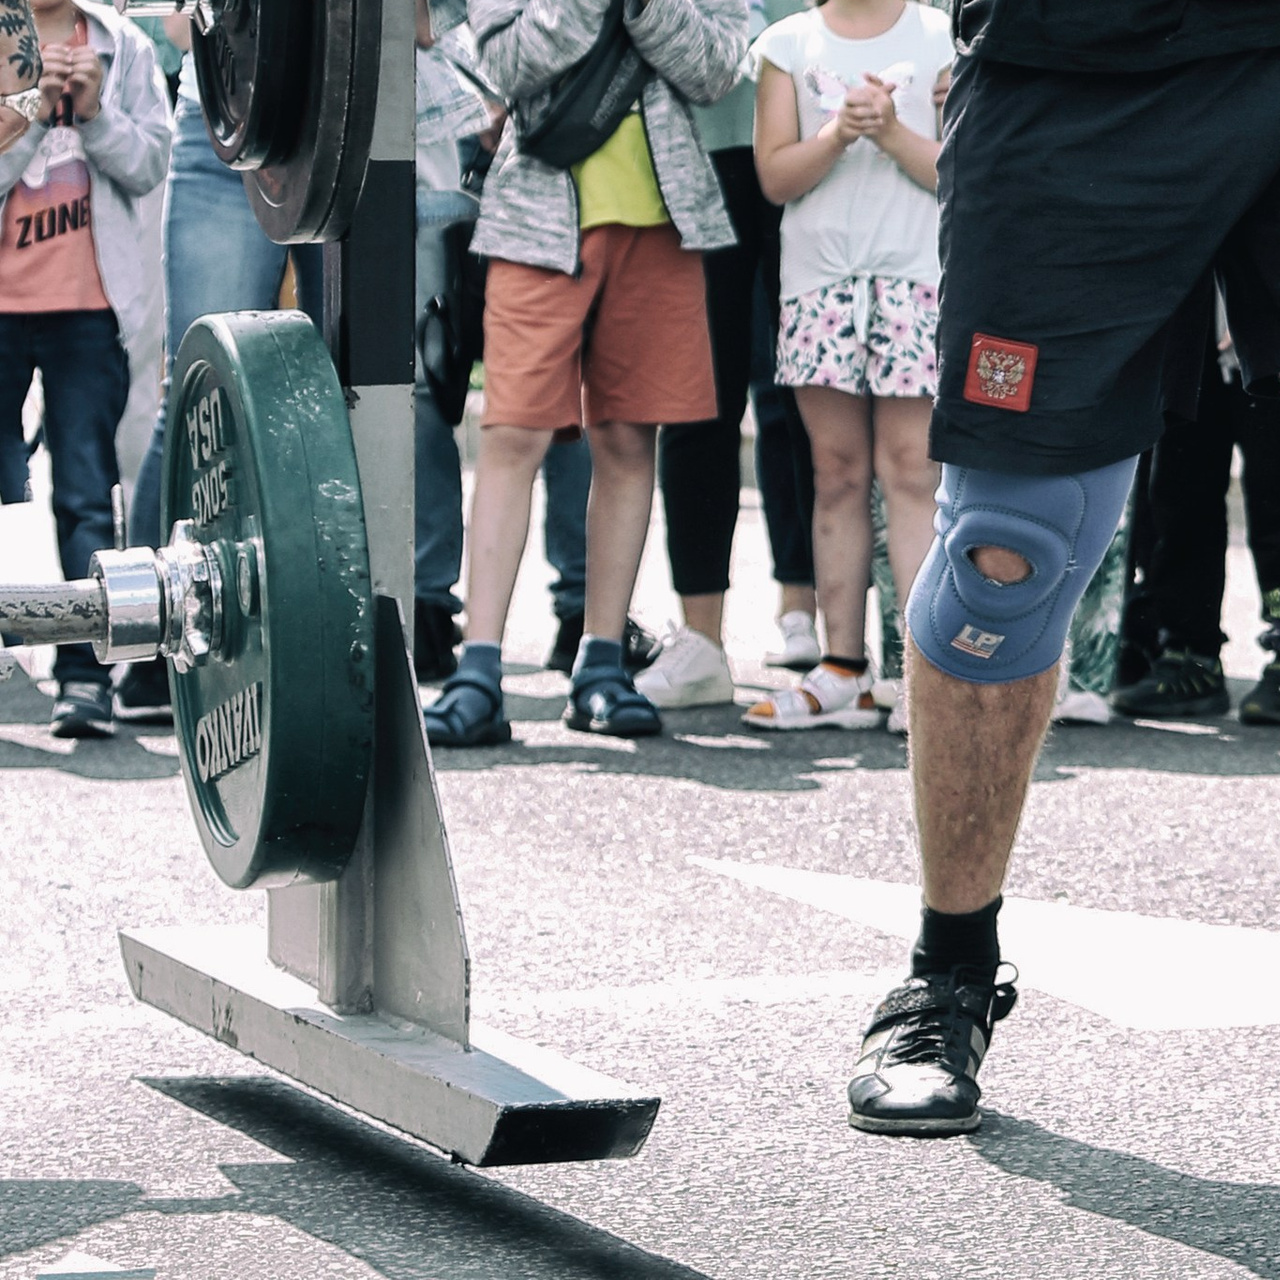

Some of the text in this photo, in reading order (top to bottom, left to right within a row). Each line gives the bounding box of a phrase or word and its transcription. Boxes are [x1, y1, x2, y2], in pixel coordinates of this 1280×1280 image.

[186, 387, 223, 470] USA
[192, 459, 229, 527] 50KG
[954, 623, 1004, 652] LP
[196, 682, 260, 783] IVANKO
